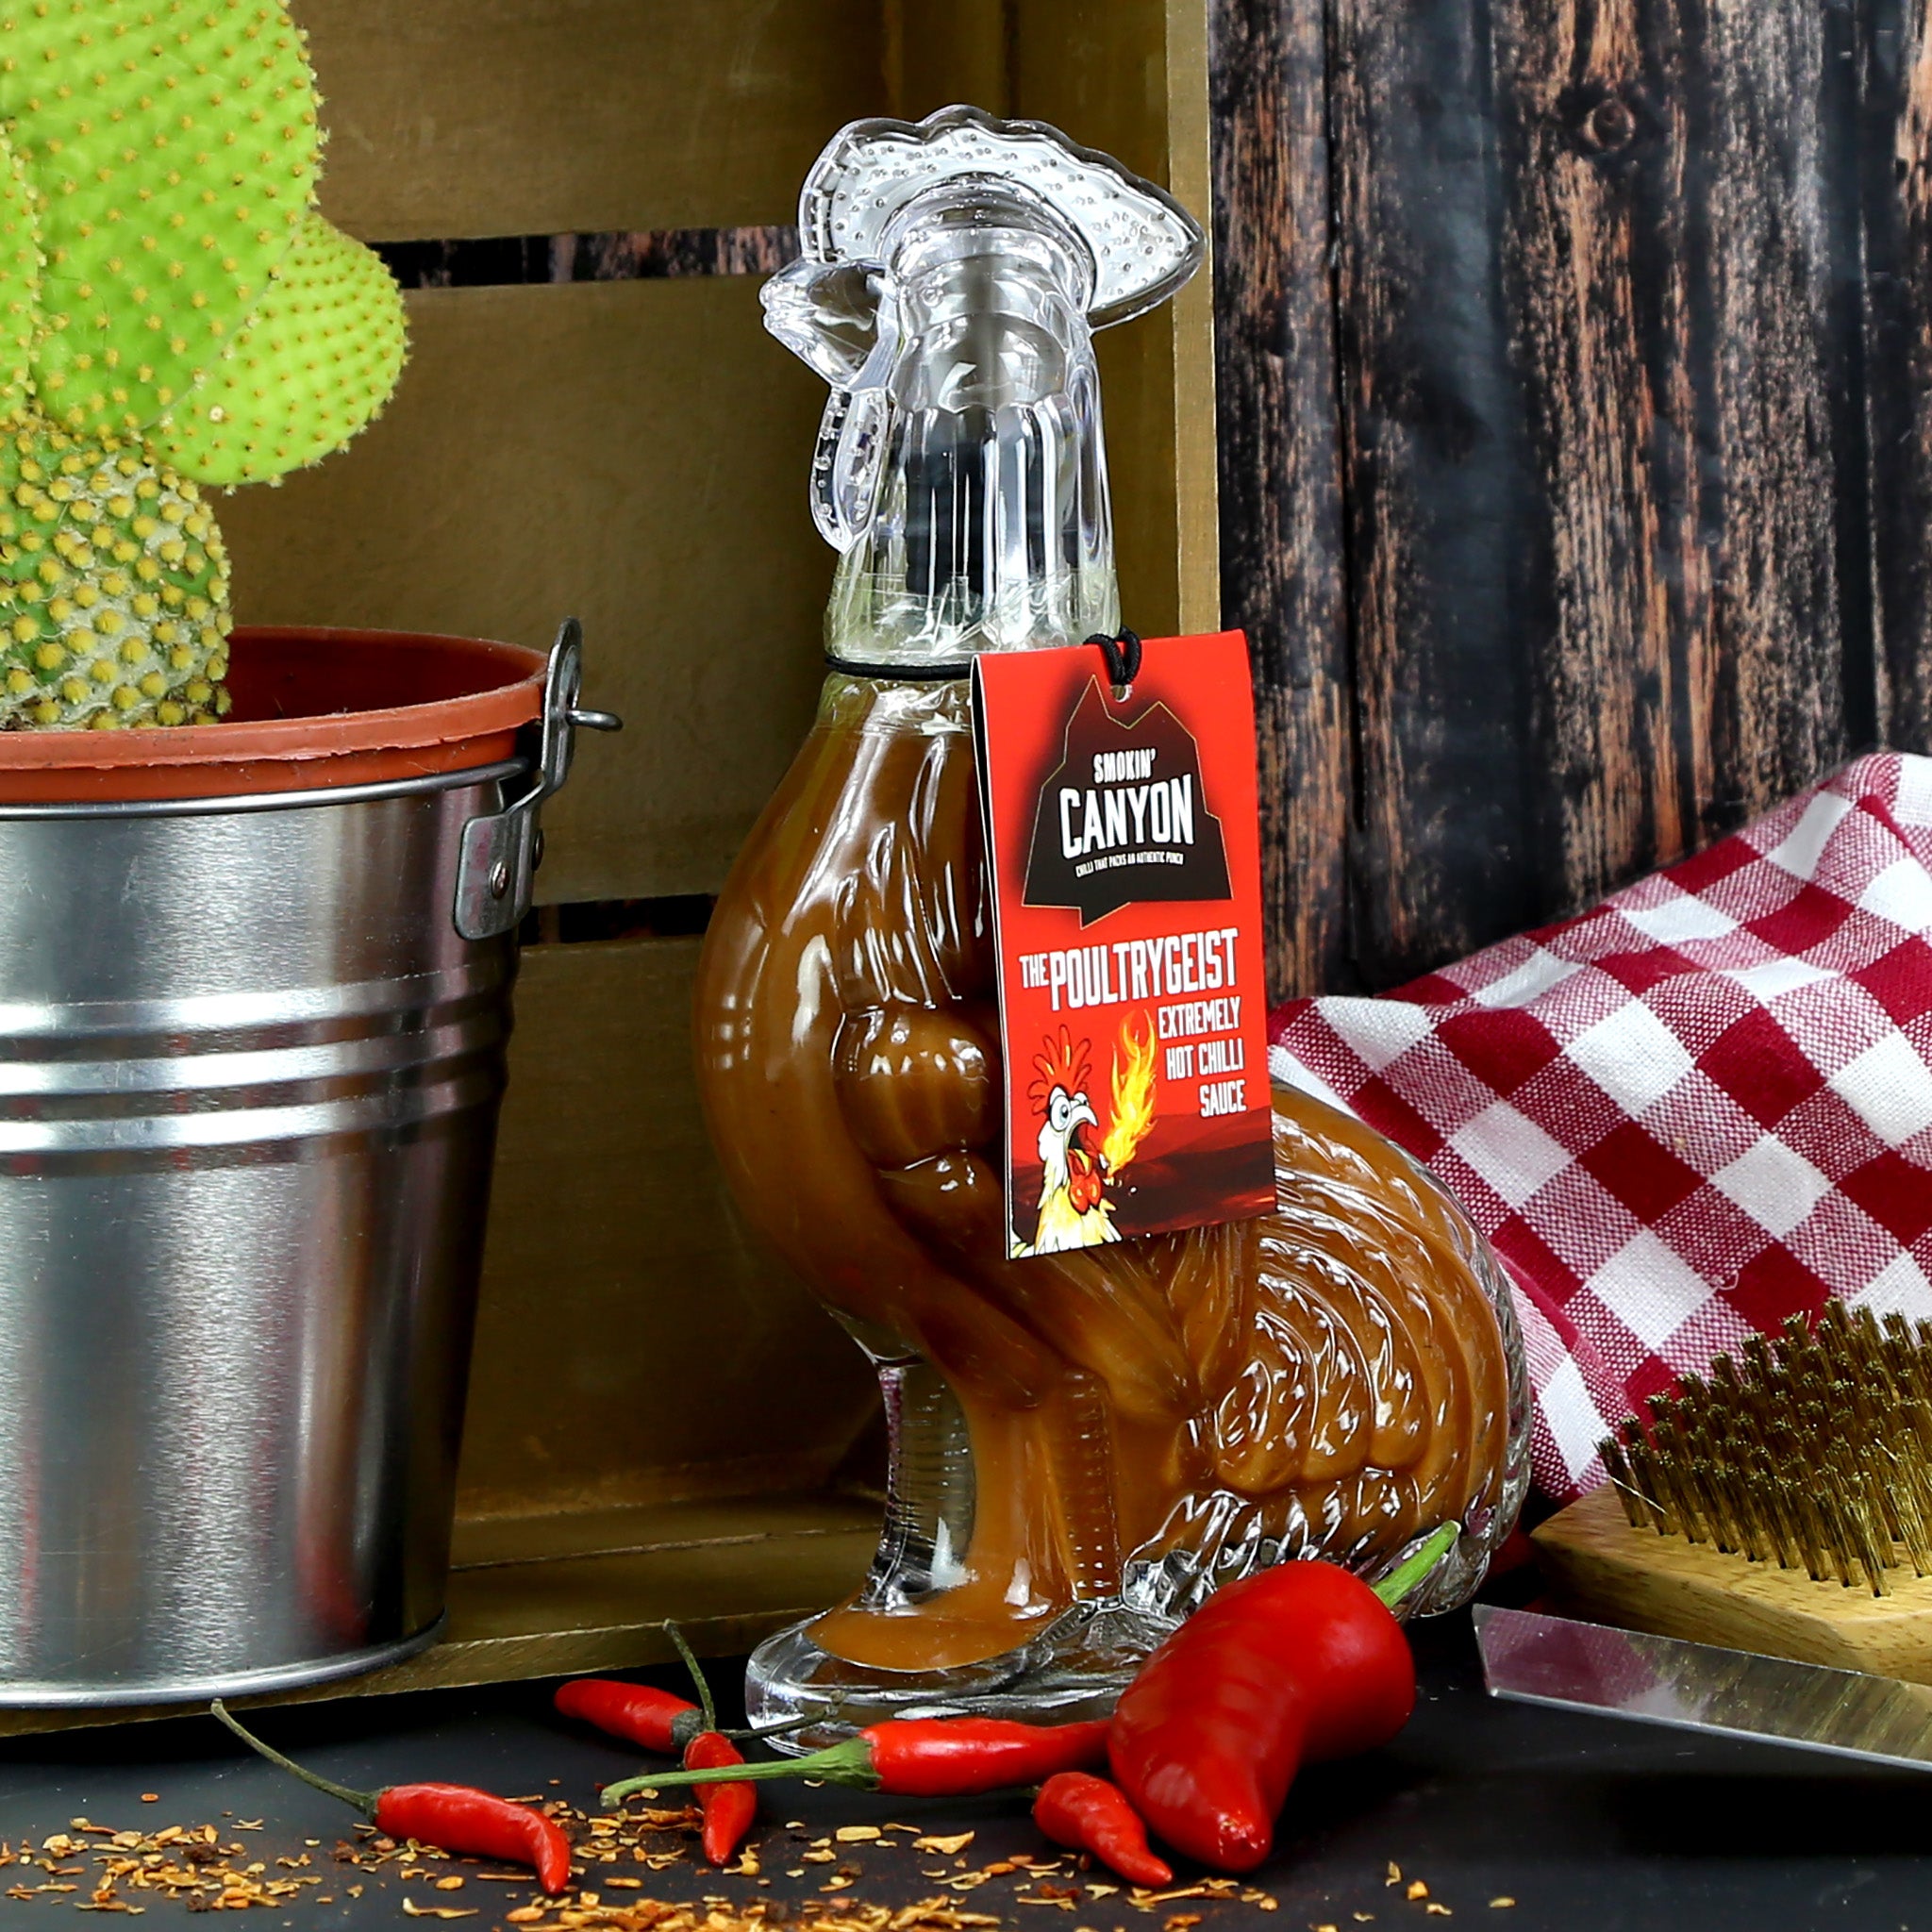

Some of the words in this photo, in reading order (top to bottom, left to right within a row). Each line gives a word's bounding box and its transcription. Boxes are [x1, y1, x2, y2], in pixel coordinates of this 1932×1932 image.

[1093, 748, 1157, 784] SMOKIN'
[1059, 774, 1194, 859] CANYON
[1019, 953, 1050, 989] THE
[1049, 927, 1239, 1011] POULTRYGEIST
[1158, 995, 1241, 1040] EXTREMELY
[1165, 1044, 1194, 1081] HOT
[1197, 1037, 1244, 1074] CHILLI
[1199, 1079, 1247, 1118] SAUCE
